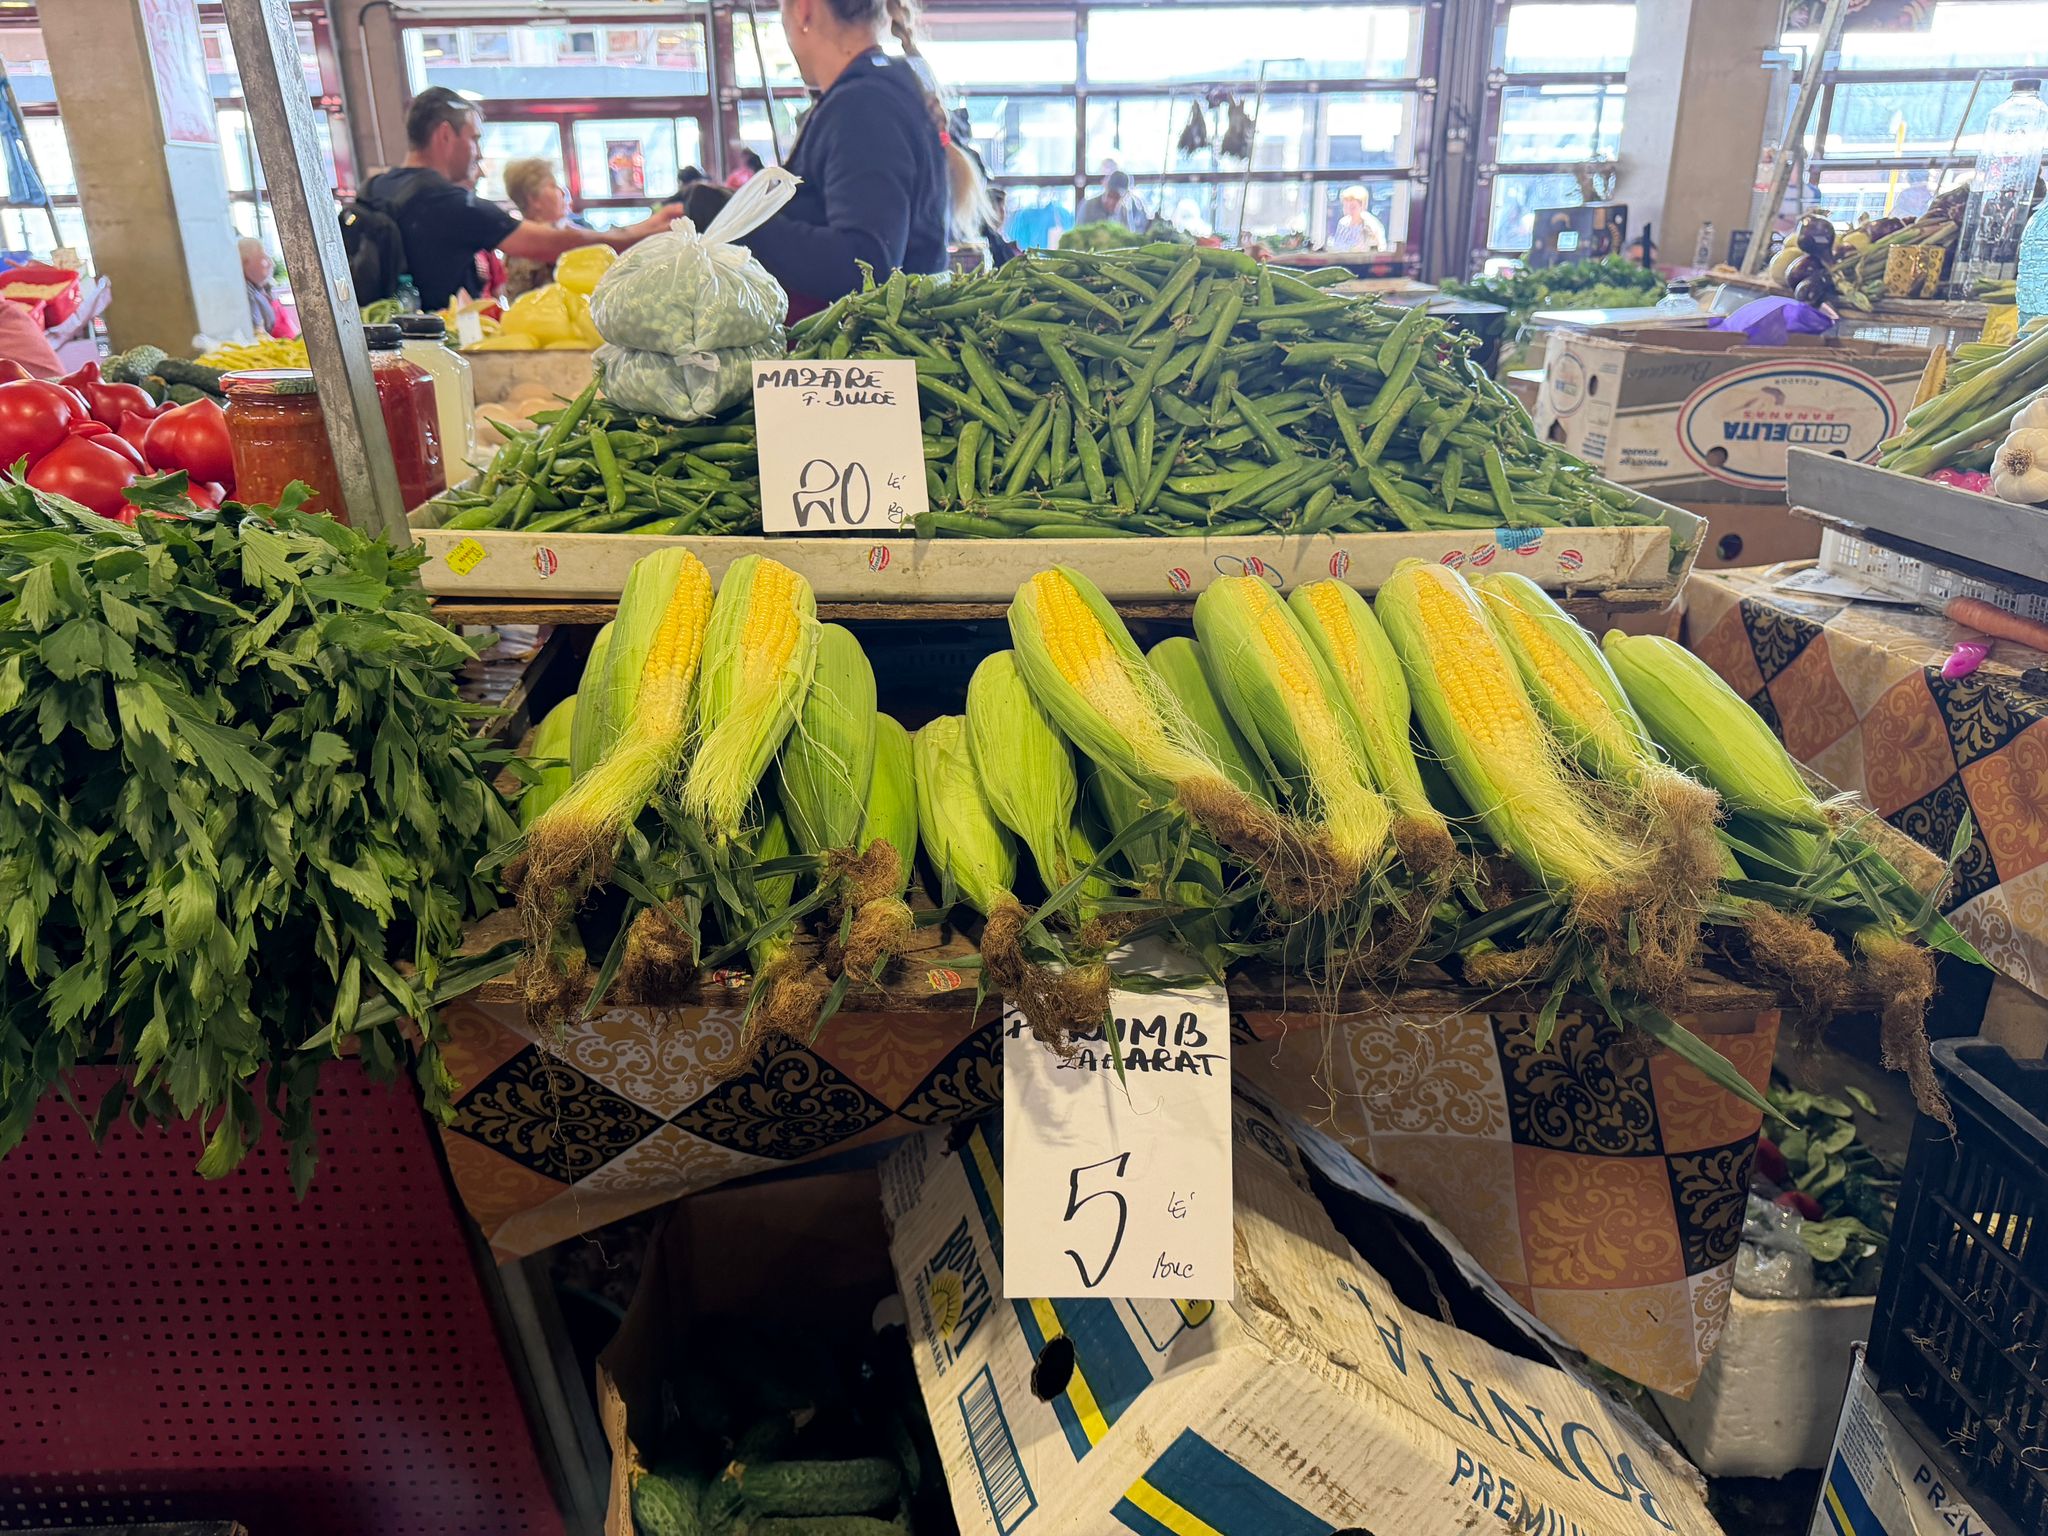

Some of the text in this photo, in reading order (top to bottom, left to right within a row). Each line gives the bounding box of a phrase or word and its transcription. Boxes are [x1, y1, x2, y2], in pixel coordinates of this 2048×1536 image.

[1744, 411, 1835, 421] BANANAS
[792, 459, 870, 527] 20
[1005, 1010, 1208, 1047] PUMB
[1063, 1151, 1131, 1288] 5
[929, 1214, 993, 1359] BONITA
